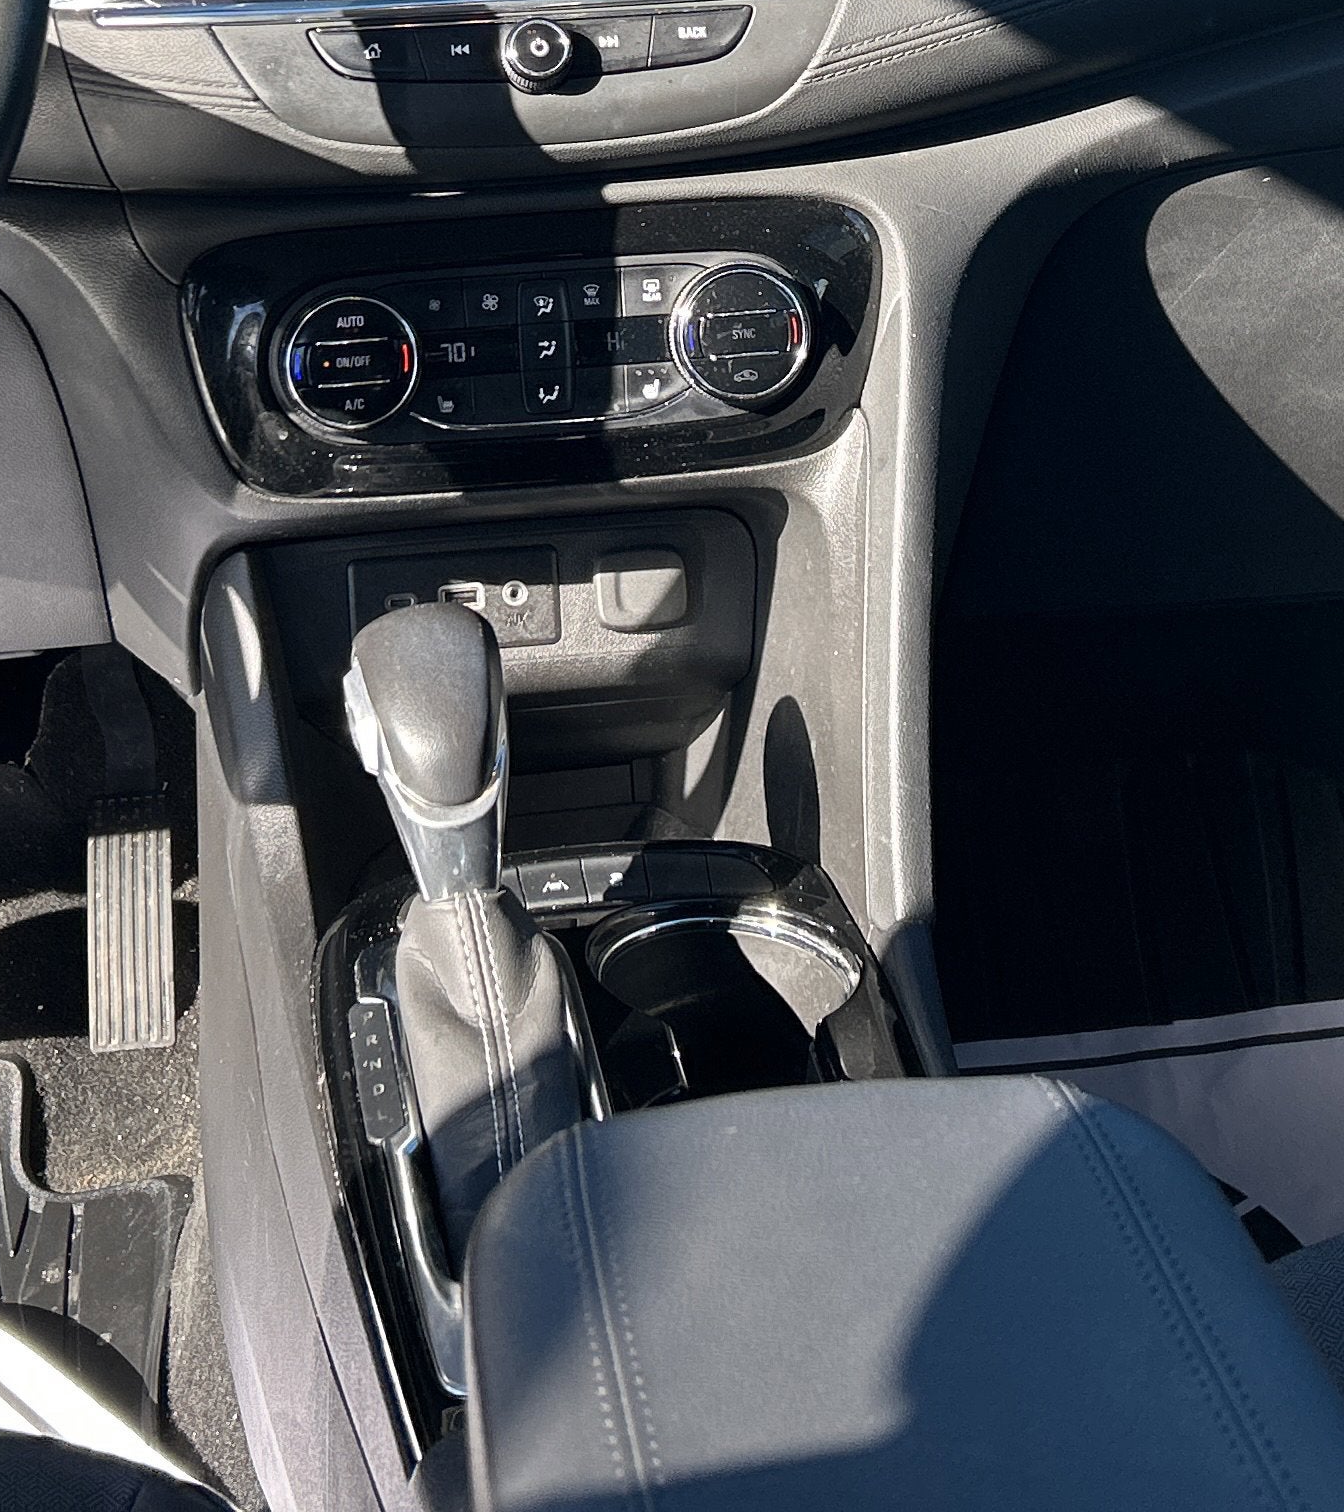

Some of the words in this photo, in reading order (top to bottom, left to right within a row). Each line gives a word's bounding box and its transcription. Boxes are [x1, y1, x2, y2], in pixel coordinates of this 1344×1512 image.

[677, 26, 708, 39] BACK
[583, 297, 601, 306] MAX
[336, 315, 365, 329] AUTO
[732, 328, 757, 340] SYNC
[335, 354, 371, 369] ON/OFF
[344, 397, 366, 412] A/C
[362, 1010, 374, 1026] P
[373, 1082, 385, 1097] D
